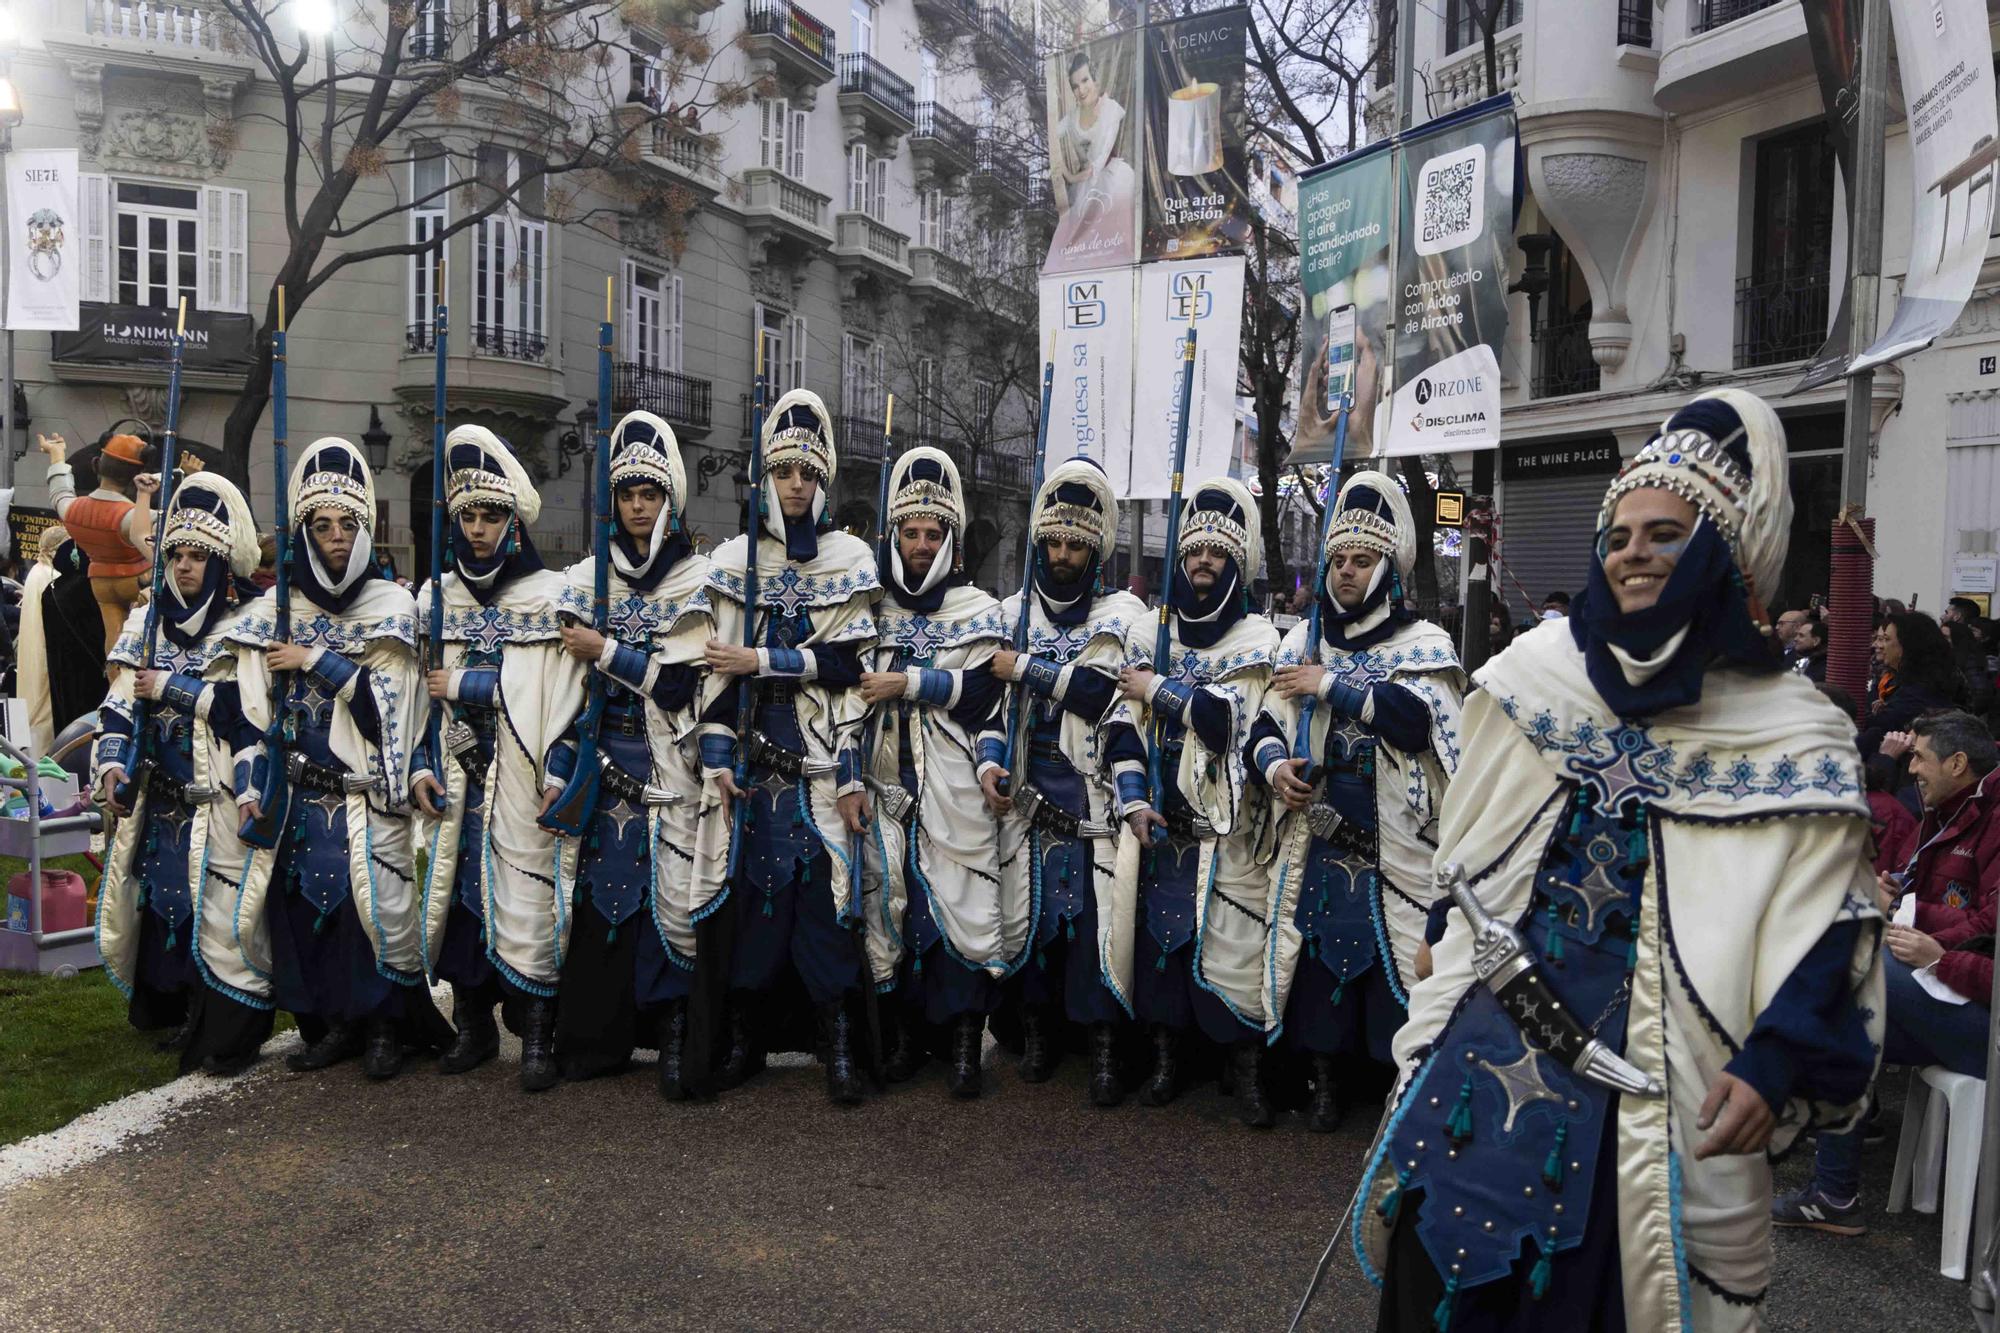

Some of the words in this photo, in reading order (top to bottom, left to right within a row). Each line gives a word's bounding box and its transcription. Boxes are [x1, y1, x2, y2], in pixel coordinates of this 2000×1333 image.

[1912, 85, 1938, 115] DISEÑAMOS
[1944, 60, 1965, 86] ESPACIO
[1914, 102, 1940, 132] PROYECTOS
[26, 169, 58, 182] SIE7E
[1164, 197, 1189, 212] Que
[1192, 192, 1225, 206] arda
[1307, 189, 1329, 209] ¿Has
[1165, 212, 1176, 225] la
[1180, 207, 1223, 223] Pasión
[1307, 198, 1351, 225] apagado
[1307, 226, 1316, 240] el
[1316, 220, 1336, 237] aire
[1307, 222, 1381, 257] acondicionado
[1308, 261, 1317, 273] al
[1318, 251, 1342, 271] salir?
[1404, 268, 1482, 298] Compruébalo
[1405, 303, 1424, 317] con
[1426, 293, 1461, 312] Aidoo
[1405, 320, 1418, 334] de
[1420, 312, 1464, 331] Airzone
[104, 336, 130, 345] VIAJES
[131, 338, 141, 346] DE
[143, 339, 171, 348] NOVIOS
[1074, 342, 1088, 367] sa
[1982, 358, 1994, 373] 14
[1416, 376, 1482, 405] AIRZONE
[1072, 376, 1094, 458] ngüesa
[1426, 412, 1486, 428] DISCLIMA
[1443, 427, 1486, 438] disclima.com
[1518, 456, 1537, 468] THE
[1541, 452, 1569, 465] WINE
[1574, 448, 1610, 462] PLACE
